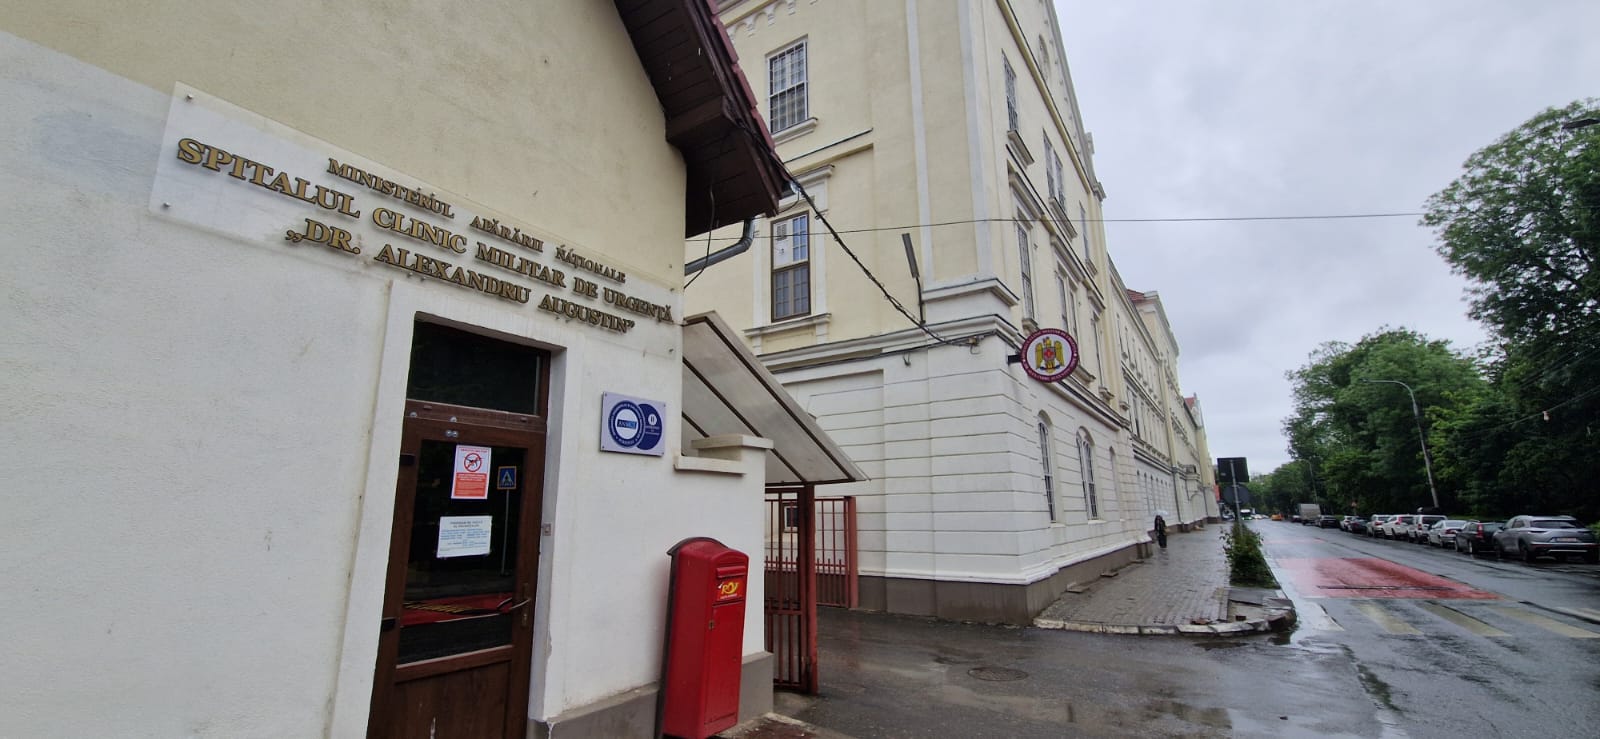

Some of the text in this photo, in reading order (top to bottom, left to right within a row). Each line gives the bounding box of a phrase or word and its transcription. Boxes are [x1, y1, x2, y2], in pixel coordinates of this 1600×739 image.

[177, 138, 674, 323] SPITALUL CLINIC MILITAR DE URGENȚĂ
[327, 158, 626, 283] MINISTERUL APĂRĂRII NAȚIONALE
[374, 244, 532, 304] ALEXANDRU
